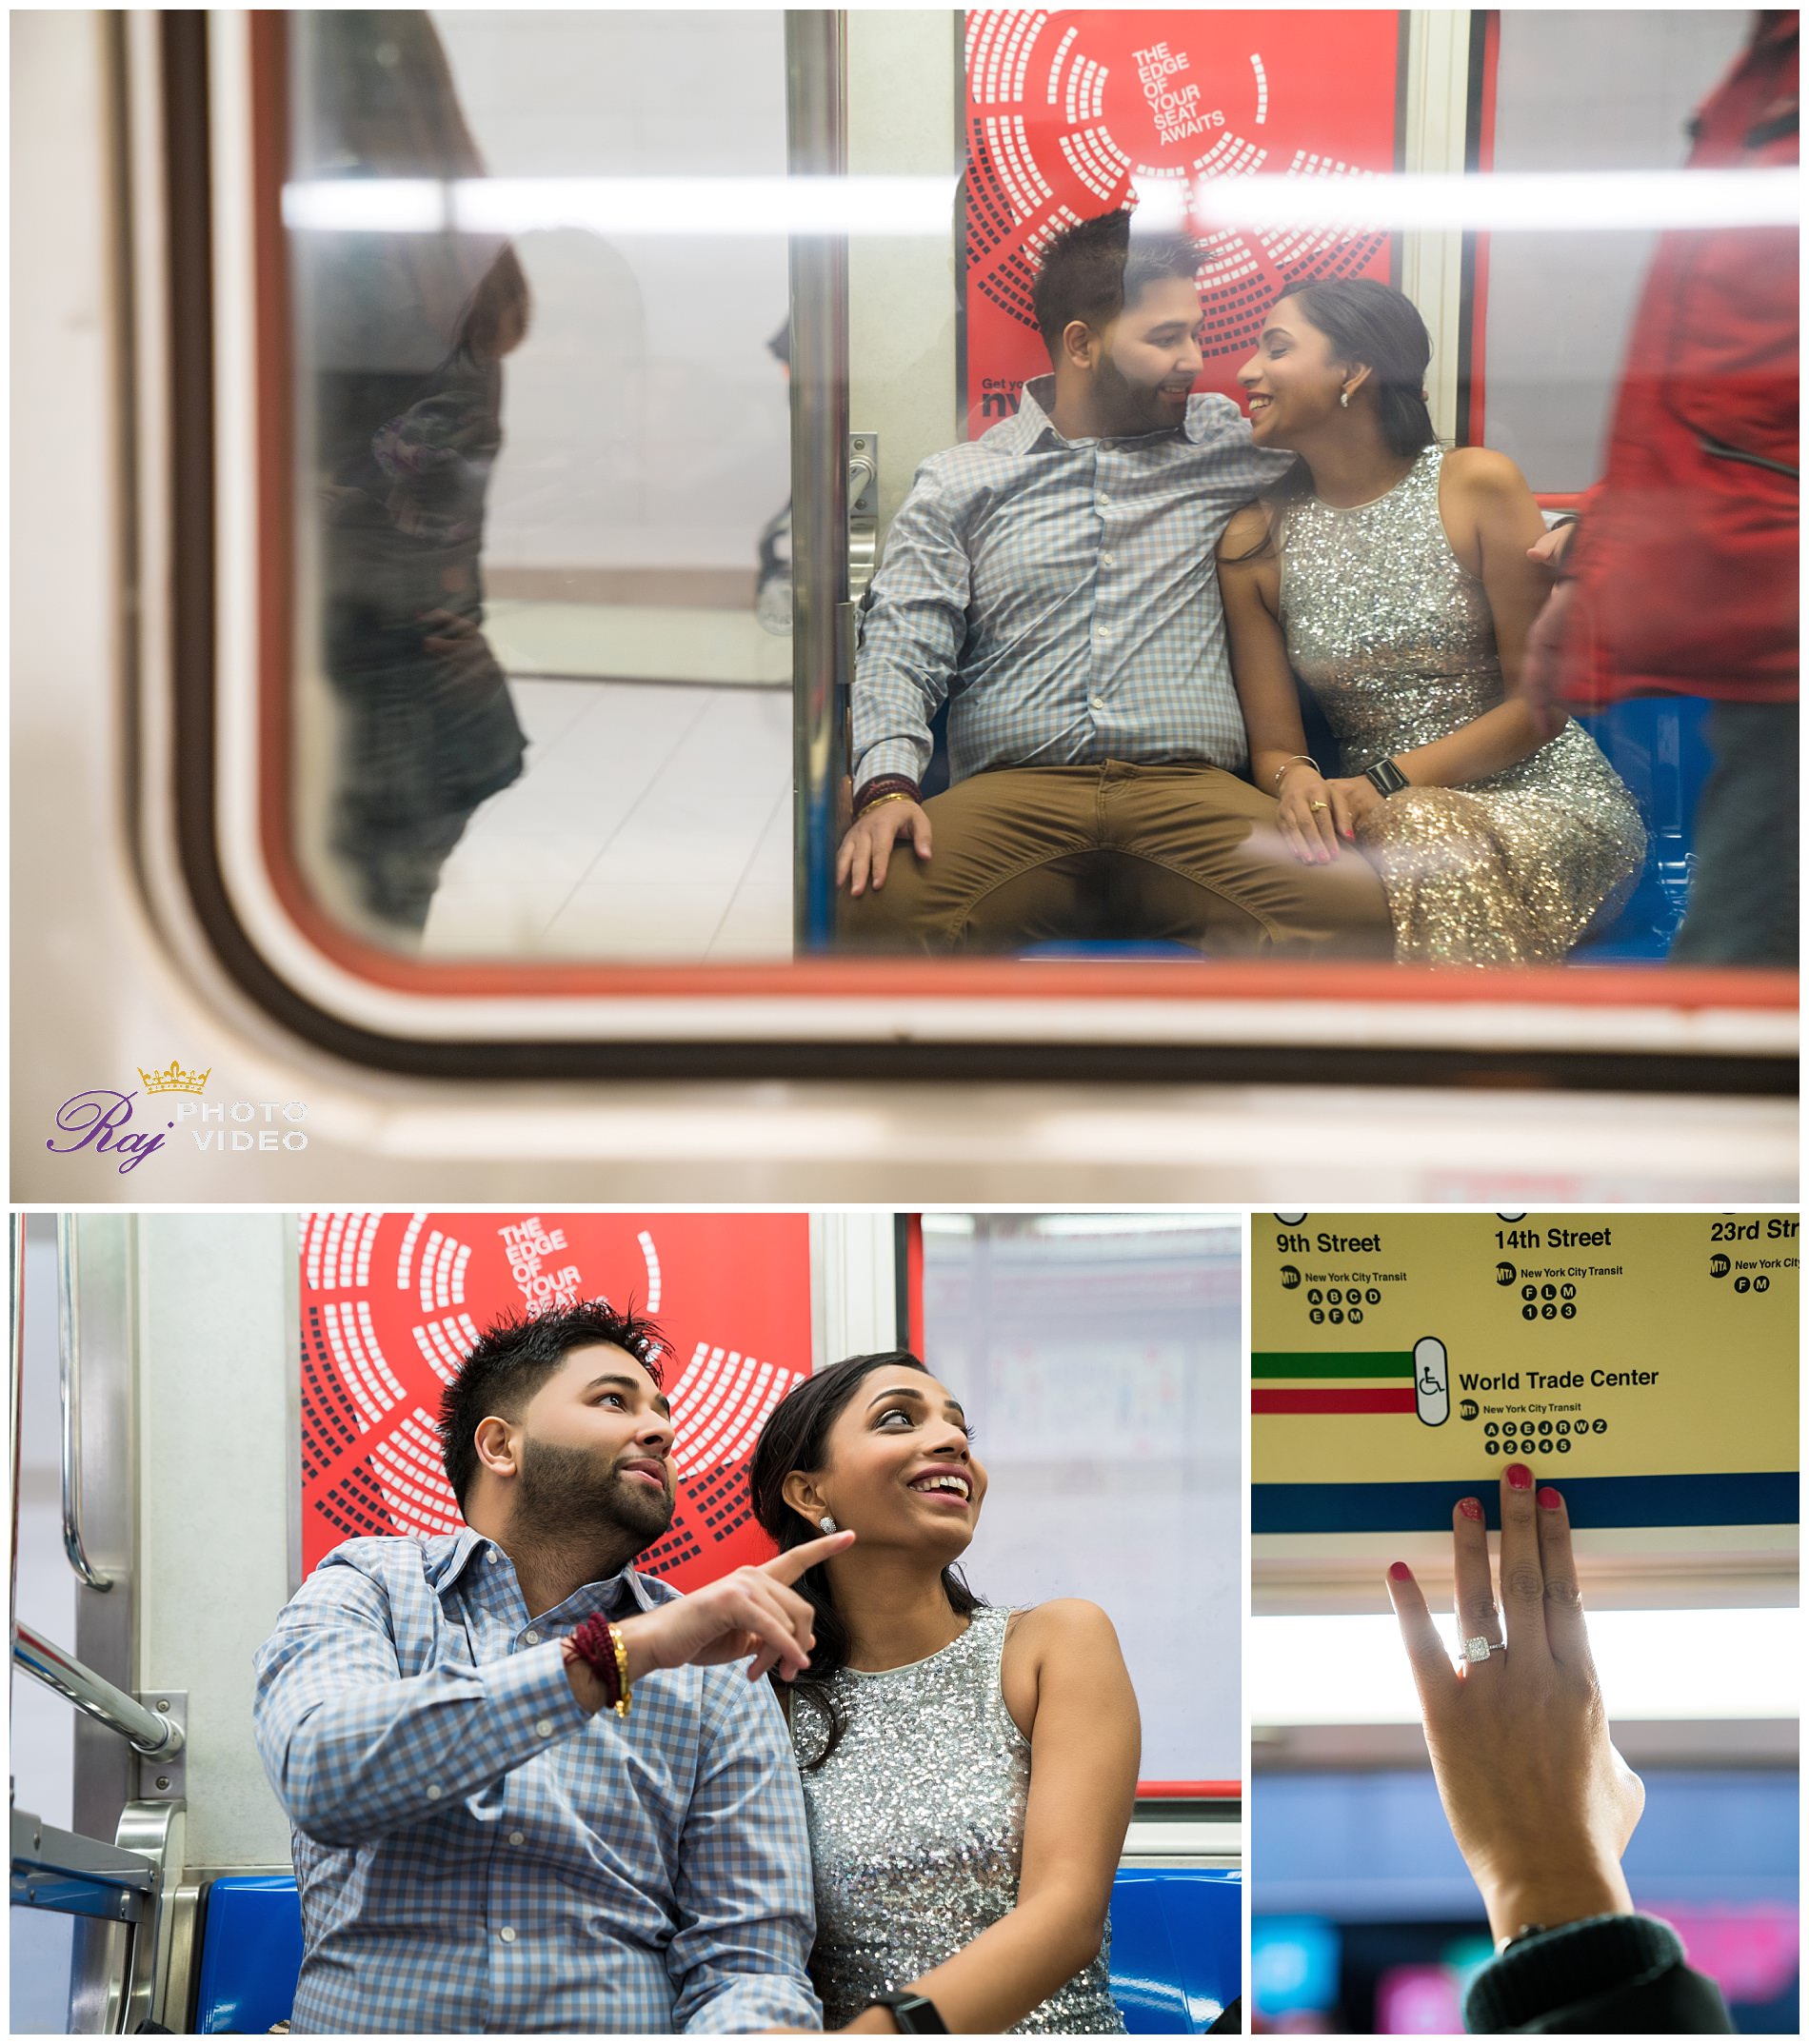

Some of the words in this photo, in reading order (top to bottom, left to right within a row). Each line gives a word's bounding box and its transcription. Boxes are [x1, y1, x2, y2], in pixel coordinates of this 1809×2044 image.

[1132, 42, 1171, 67] THE
[1138, 51, 1190, 84] EDGE
[1143, 76, 1168, 99] OF
[1147, 84, 1201, 113] YOUR
[1154, 101, 1198, 130] SEAT
[1161, 110, 1225, 146] AWAITS
[983, 378, 1005, 389] Get
[497, 1217, 545, 1246] THE
[1496, 1230, 1540, 1249] 14th
[1548, 1228, 1611, 1247] Street
[1711, 1220, 1759, 1241] 23rd
[1767, 1219, 1799, 1239] Str
[506, 1228, 568, 1265] EDGE
[1277, 1234, 1310, 1252] 9th
[1318, 1234, 1382, 1252] Street
[512, 1257, 542, 1283] OF
[1305, 1273, 1326, 1281] New
[1327, 1273, 1349, 1281] York
[1352, 1272, 1371, 1283] City
[1373, 1272, 1406, 1281] Transit
[1496, 1265, 1515, 1283] MTA
[1521, 1269, 1541, 1278] New
[1544, 1268, 1565, 1277] York
[1568, 1268, 1586, 1278] City
[1588, 1266, 1622, 1276] Transit
[1710, 1259, 1728, 1275] MTA
[1736, 1260, 1758, 1269] New
[1759, 1259, 1781, 1268] York
[1783, 1258, 1799, 1269] Cit
[518, 1265, 582, 1300] YOUR
[1459, 1373, 1520, 1390] World
[1526, 1371, 1584, 1389] Trade
[1590, 1370, 1659, 1387] Center
[1483, 1405, 1503, 1414] New
[1505, 1404, 1526, 1413] York
[1529, 1403, 1546, 1415] City
[1549, 1403, 1580, 1412] Transit
